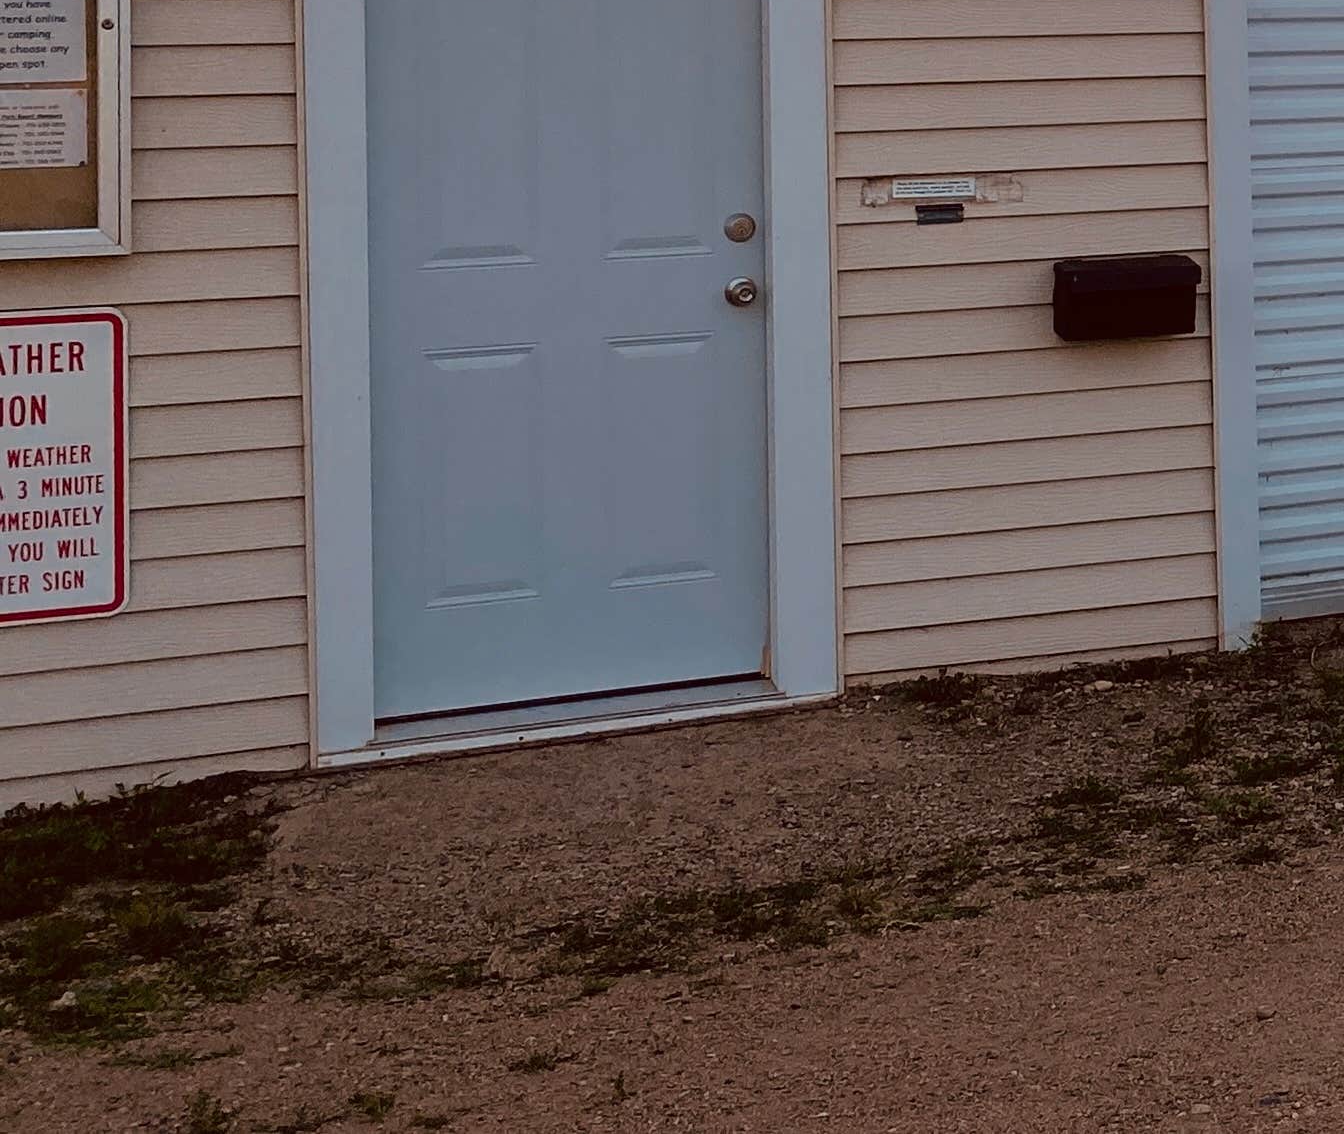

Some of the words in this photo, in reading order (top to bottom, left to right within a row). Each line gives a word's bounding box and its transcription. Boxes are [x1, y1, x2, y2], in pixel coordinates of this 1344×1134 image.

[26, 0, 51, 8] have
[35, 14, 67, 23] online
[8, 30, 52, 40] camping
[10, 44, 47, 53] choose
[50, 46, 70, 55] any
[7, 444, 91, 469] WEATHER
[17, 480, 28, 500] 3
[41, 474, 105, 498] MINUTE
[8, 541, 44, 563] YOU
[57, 537, 100, 559] WILL
[42, 569, 85, 592] SIGN
